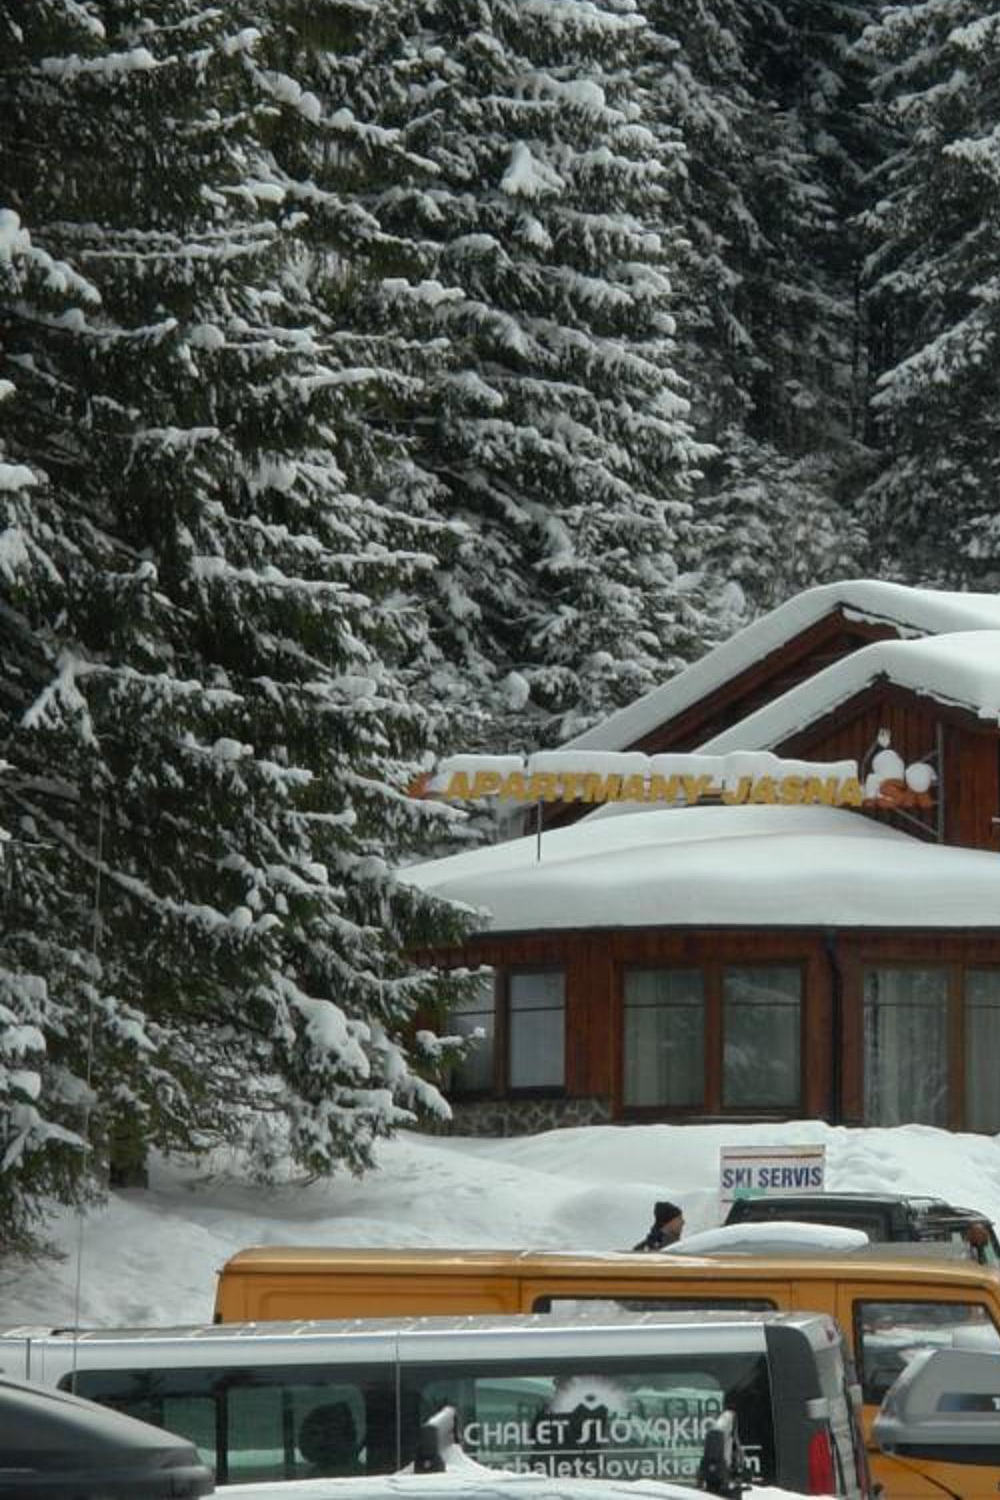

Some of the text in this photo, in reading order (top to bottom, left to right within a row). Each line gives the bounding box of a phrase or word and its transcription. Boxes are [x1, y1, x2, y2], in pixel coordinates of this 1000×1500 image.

[722, 1166, 823, 1189] SKI SERVIS
[463, 1419, 570, 1446] CHALET
